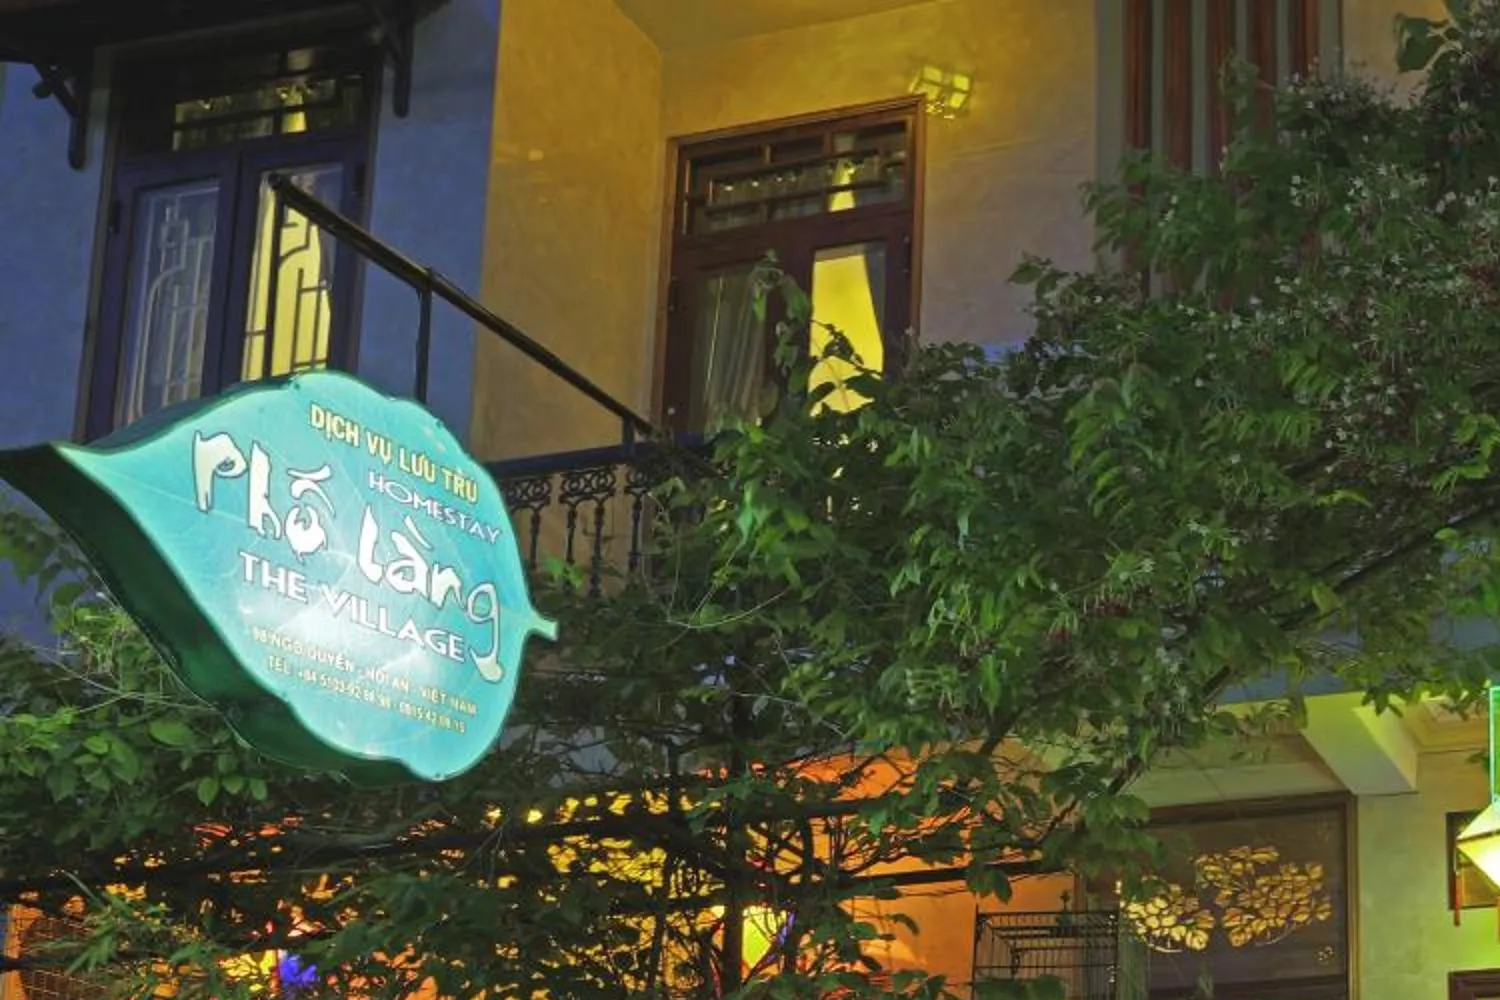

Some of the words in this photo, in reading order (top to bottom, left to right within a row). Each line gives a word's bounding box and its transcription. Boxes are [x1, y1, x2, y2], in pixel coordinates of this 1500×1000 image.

[310, 403, 360, 448] DỊCH
[366, 431, 392, 465] VỤ
[368, 470, 500, 545] HOMESTAY
[239, 549, 309, 606] THE
[319, 582, 466, 663] VILLAGE
